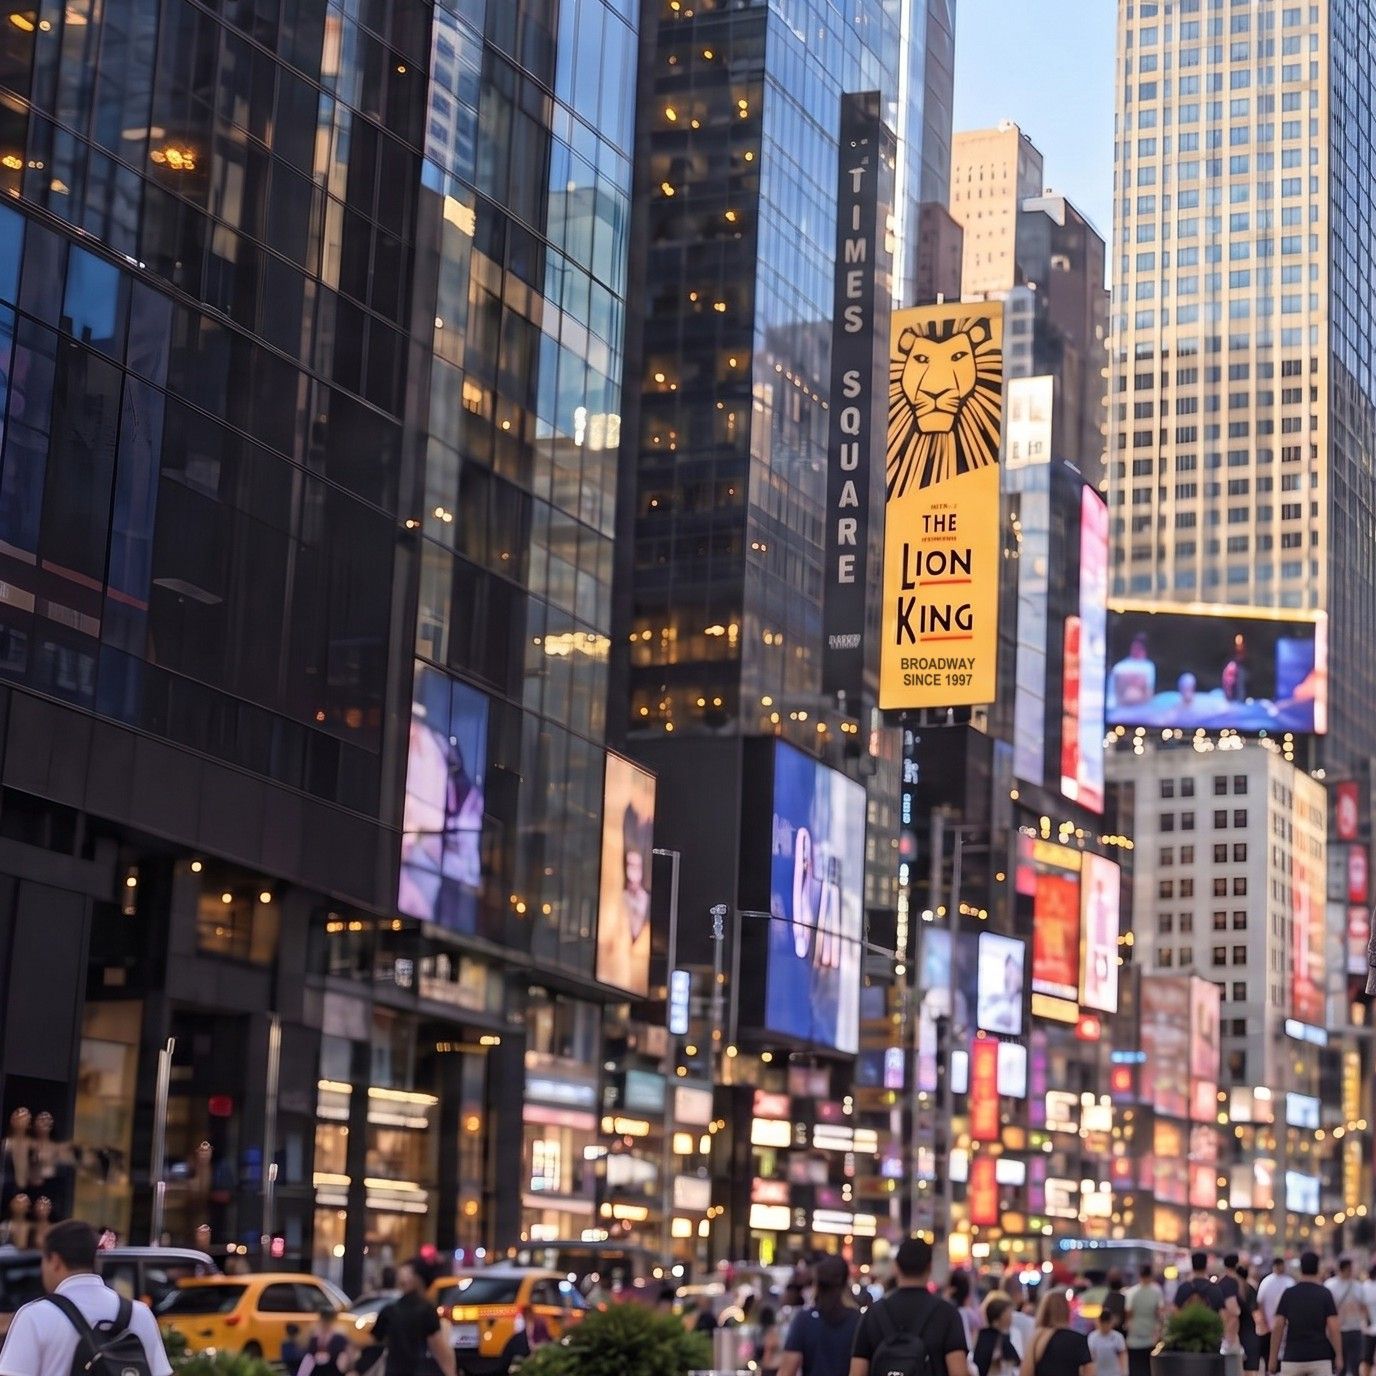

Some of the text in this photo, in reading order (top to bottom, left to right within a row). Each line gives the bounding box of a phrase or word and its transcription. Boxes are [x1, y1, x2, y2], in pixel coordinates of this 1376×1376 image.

[838, 167, 867, 584] TIMES SQUARE
[921, 513, 957, 533] THE
[901, 543, 972, 591] LION
[896, 596, 973, 645] KING
[900, 657, 976, 670] BROADWAY
[903, 673, 973, 686] SINCE 1997
